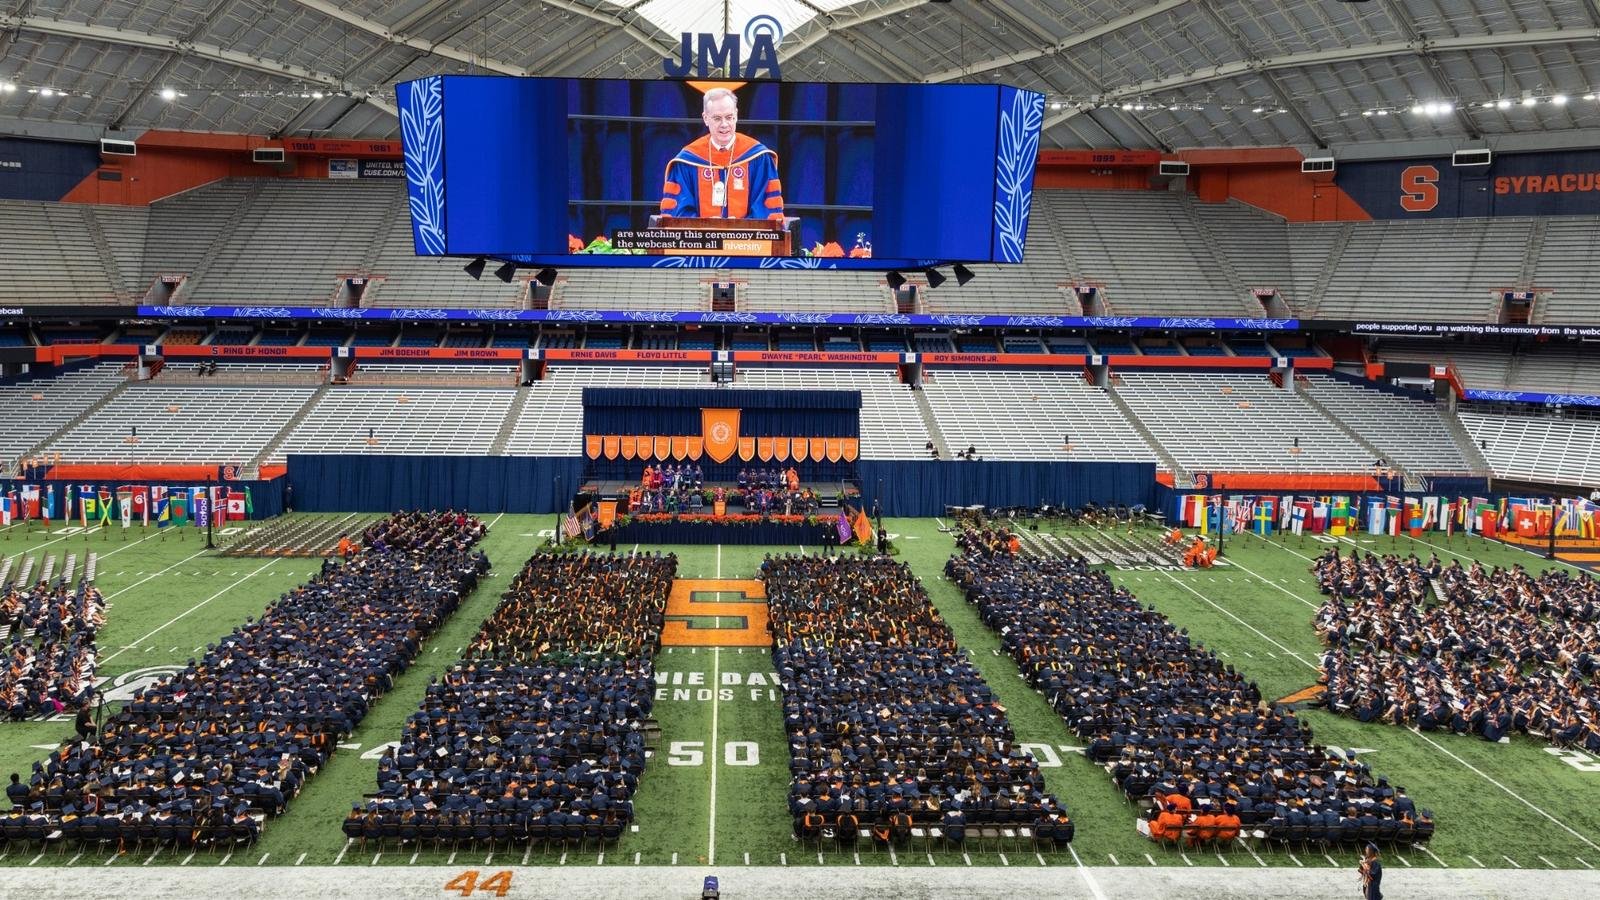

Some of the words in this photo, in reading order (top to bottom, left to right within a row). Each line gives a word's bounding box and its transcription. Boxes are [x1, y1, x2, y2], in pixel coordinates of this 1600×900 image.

[663, 32, 782, 79] JMA
[1400, 165, 1440, 212] S
[617, 240, 634, 248] the
[636, 240, 677, 248] webcast
[679, 240, 702, 248] from
[705, 240, 717, 249] all
[636, 230, 681, 240] watching
[684, 230, 703, 239] this
[705, 232, 753, 240] ceremony
[755, 231, 779, 240] from
[1356, 323, 1380, 331] people
[1381, 323, 1417, 332] supported
[1450, 325, 1484, 333] watching
[1485, 325, 1500, 333] this
[1500, 326, 1540, 335] ceremony
[1541, 326, 1560, 334] from
[1564, 327, 1578, 335] the
[223, 347, 243, 355] RING
[245, 347, 256, 355] OF
[258, 347, 288, 355] HONOR
[667, 741, 760, 767] 50
[443, 870, 514, 897] 44
